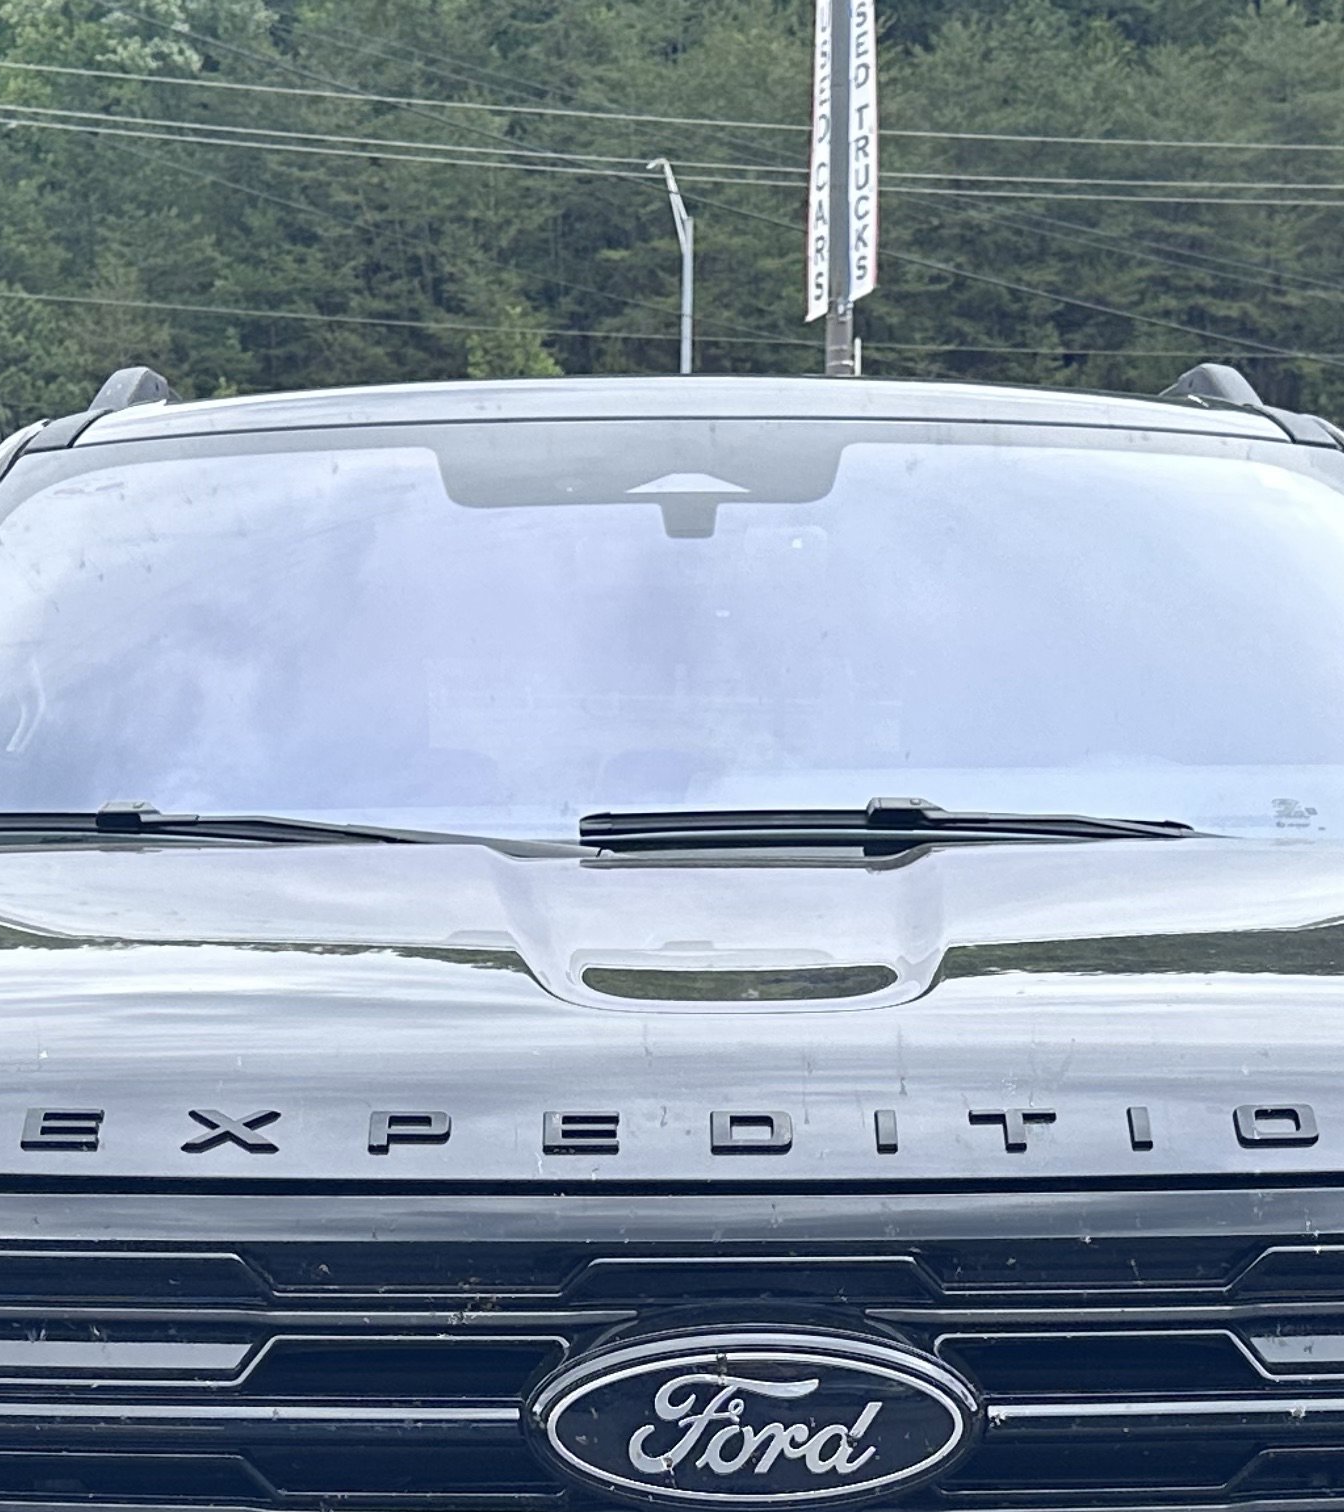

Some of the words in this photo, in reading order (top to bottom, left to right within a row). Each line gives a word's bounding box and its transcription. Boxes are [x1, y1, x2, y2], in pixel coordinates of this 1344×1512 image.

[854, 0, 870, 90] SED
[814, 162, 828, 301] CARS
[853, 103, 871, 281] TRUCKS
[628, 1373, 884, 1475] Ford
